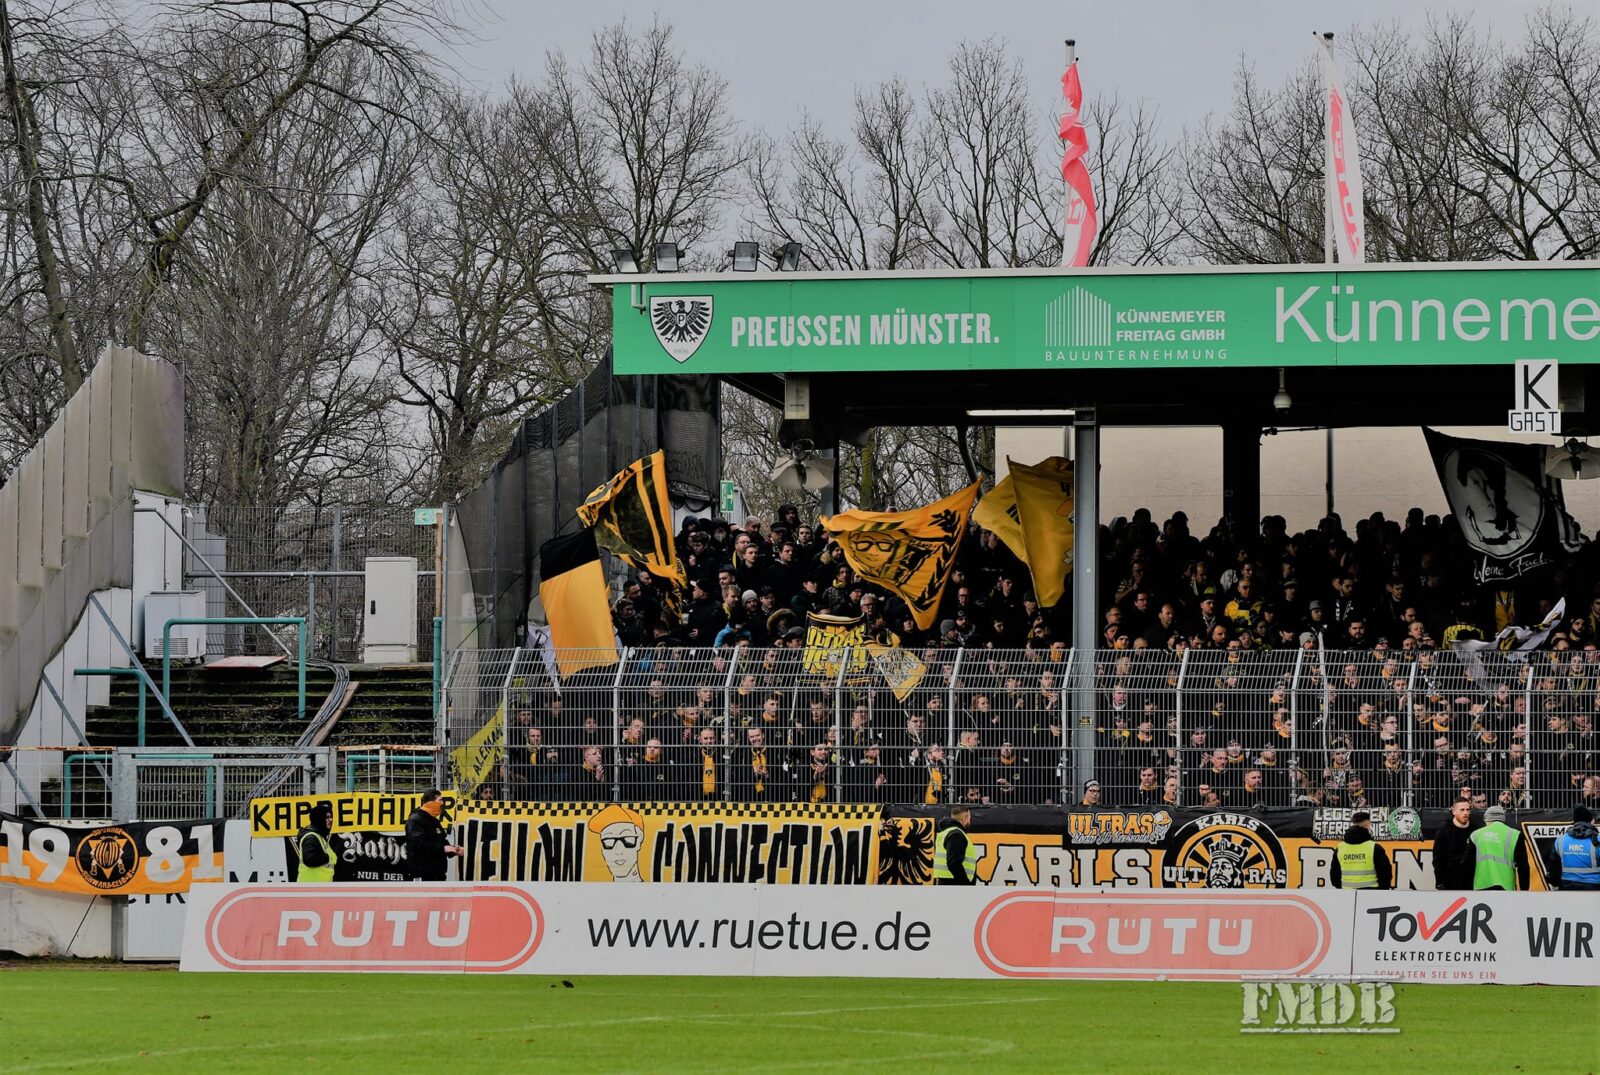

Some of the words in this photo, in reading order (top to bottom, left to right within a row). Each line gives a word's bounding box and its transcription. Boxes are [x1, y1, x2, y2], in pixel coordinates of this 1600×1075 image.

[1116, 308, 1226, 323] KÜNNEMEYER
[1275, 285, 1600, 343] Künneme
[731, 315, 861, 347] PREUSSEN
[870, 308, 1000, 345] MÜNSTER.
[1116, 330, 1176, 342] FREITAG
[1180, 329, 1226, 341] GMBH
[1045, 349, 1228, 361] BAUUNTERNEHMUNG
[1523, 364, 1552, 410] K
[1510, 412, 1559, 433] GAST
[1068, 813, 1155, 836] ULTRAS
[1196, 814, 1260, 832] KARLS
[1532, 827, 1567, 836] ALEM
[653, 822, 872, 885] CONNECTION
[356, 871, 379, 880] NUR
[383, 872, 404, 881] DER
[277, 910, 471, 947] RÜTÜ
[587, 911, 932, 951] www.ruetue.de
[1050, 916, 1253, 955] RÜTÜ
[1526, 916, 1594, 958] WIR
[1375, 950, 1497, 962] ELEKTROTECHNIK
[1431, 970, 1448, 979] SIE
[1453, 971, 1475, 979] UNS
[1479, 971, 1497, 980] EIN
